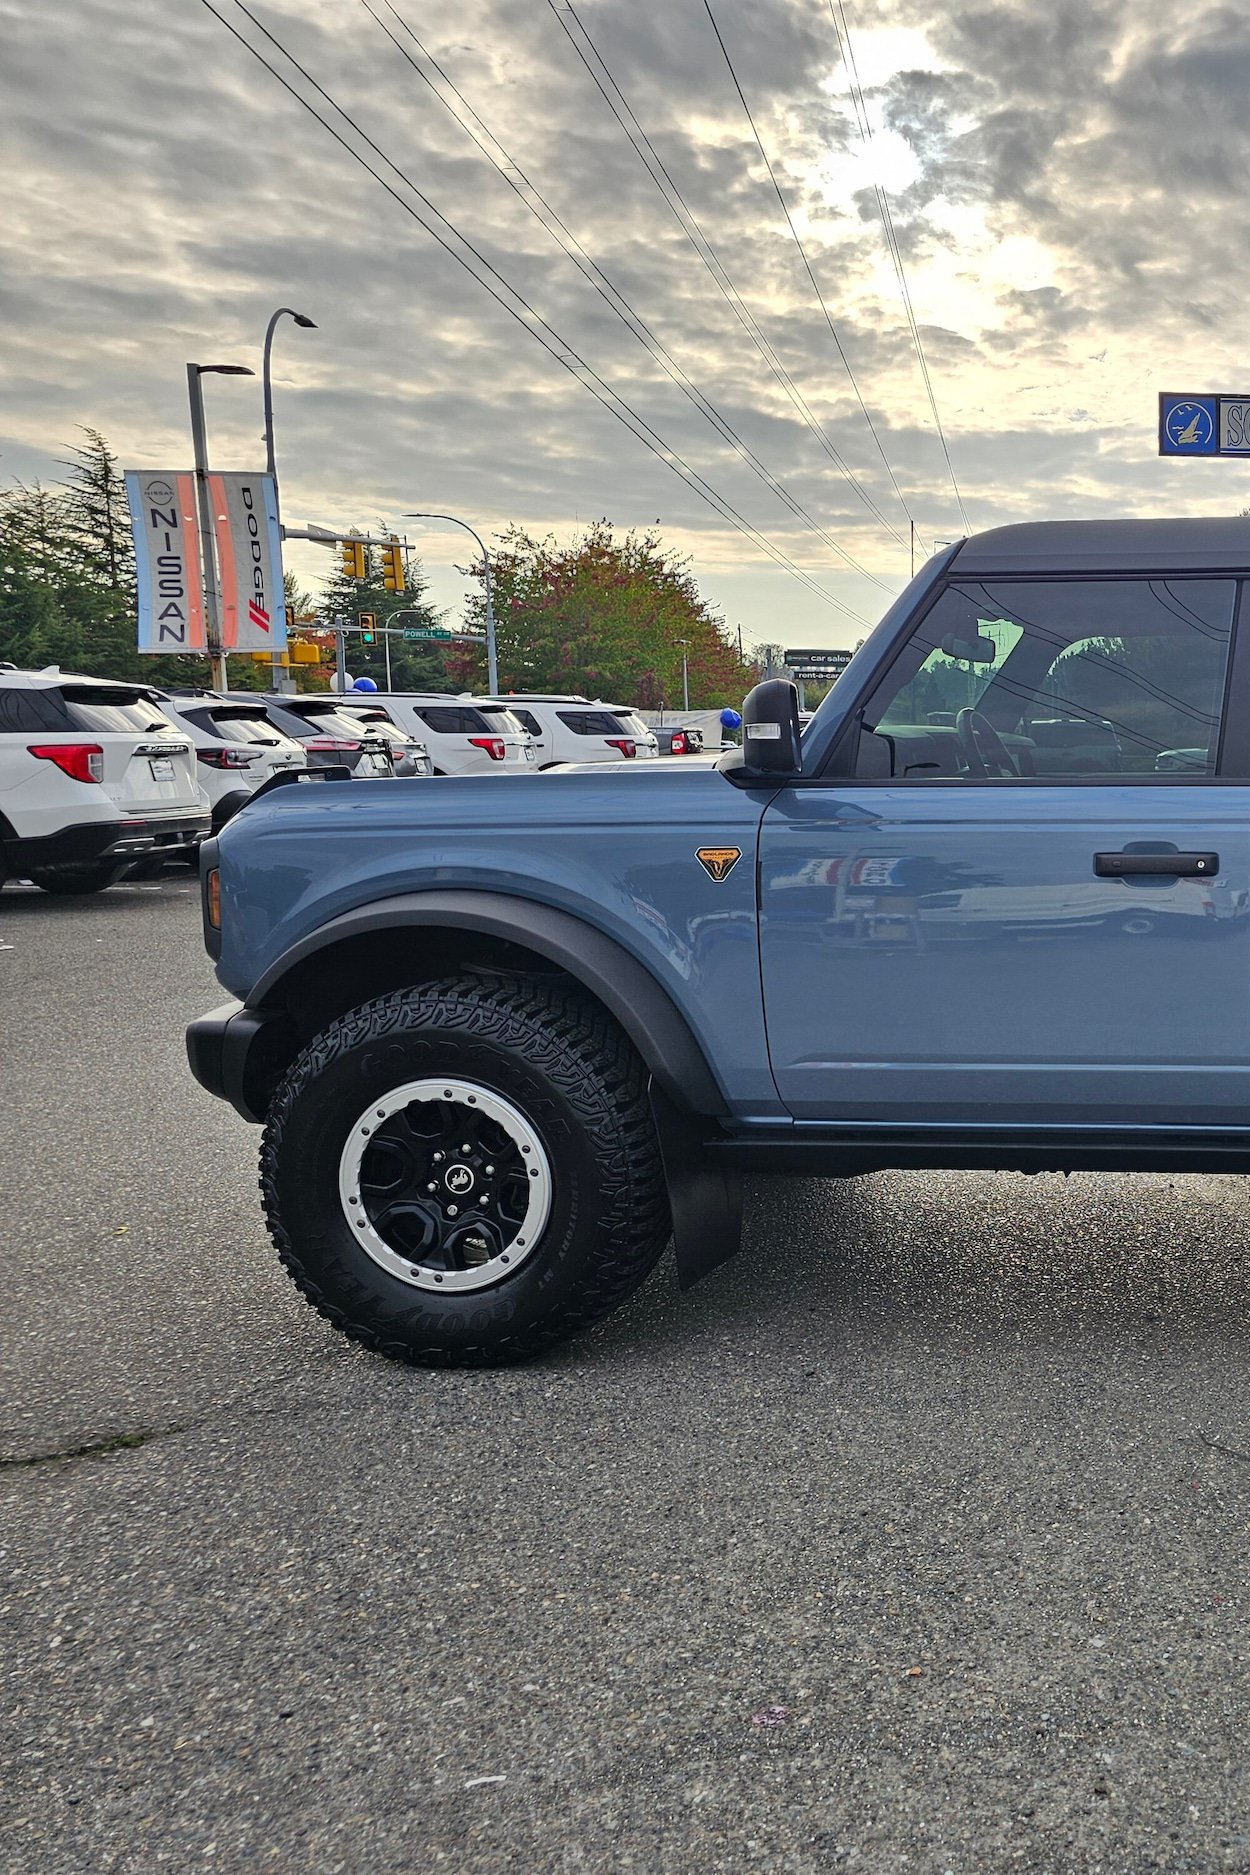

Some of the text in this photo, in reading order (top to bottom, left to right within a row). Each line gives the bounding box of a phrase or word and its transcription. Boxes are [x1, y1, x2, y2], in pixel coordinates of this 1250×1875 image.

[150, 508, 186, 643] NISSAN
[241, 487, 265, 612] DODGE
[405, 630, 436, 638] POWELL
